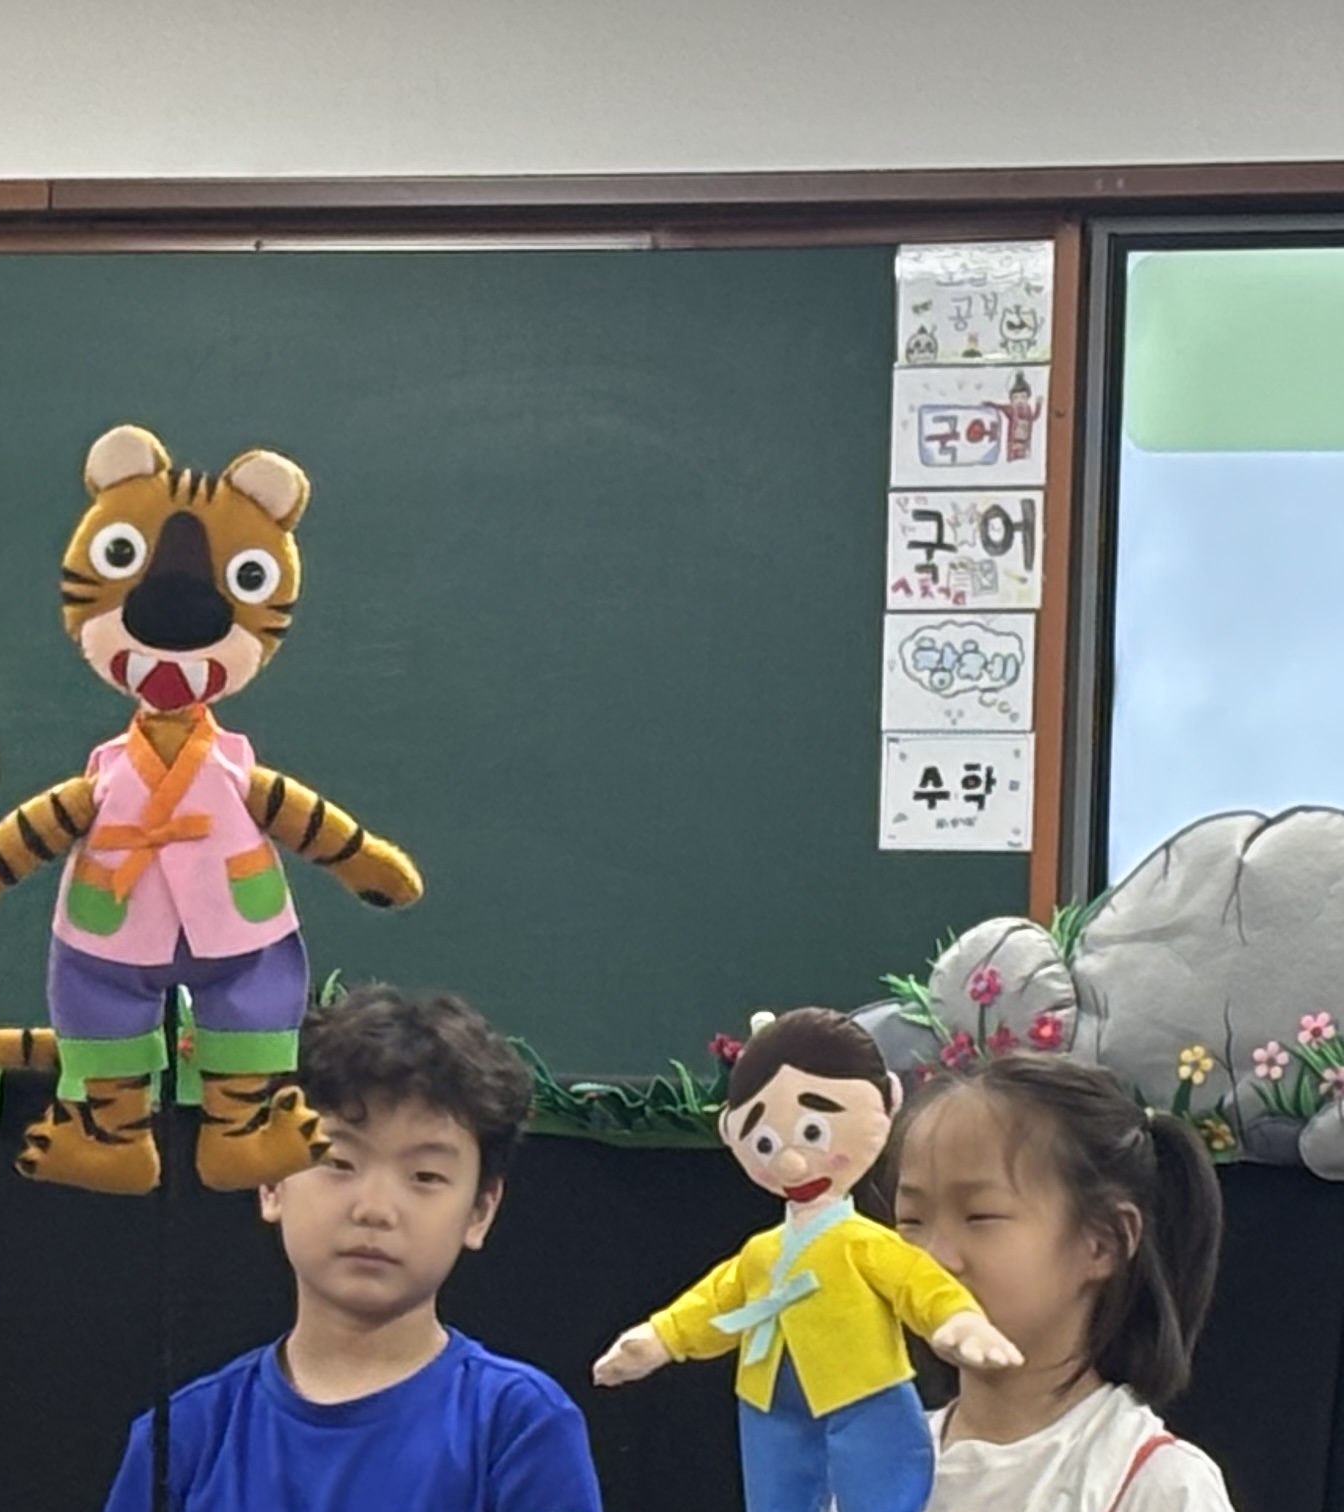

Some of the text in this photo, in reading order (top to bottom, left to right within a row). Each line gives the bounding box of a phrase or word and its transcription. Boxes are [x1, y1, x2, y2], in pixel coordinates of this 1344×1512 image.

[925, 415, 999, 465] 국어
[906, 498, 1037, 585] 국어
[912, 762, 998, 812] 수학
